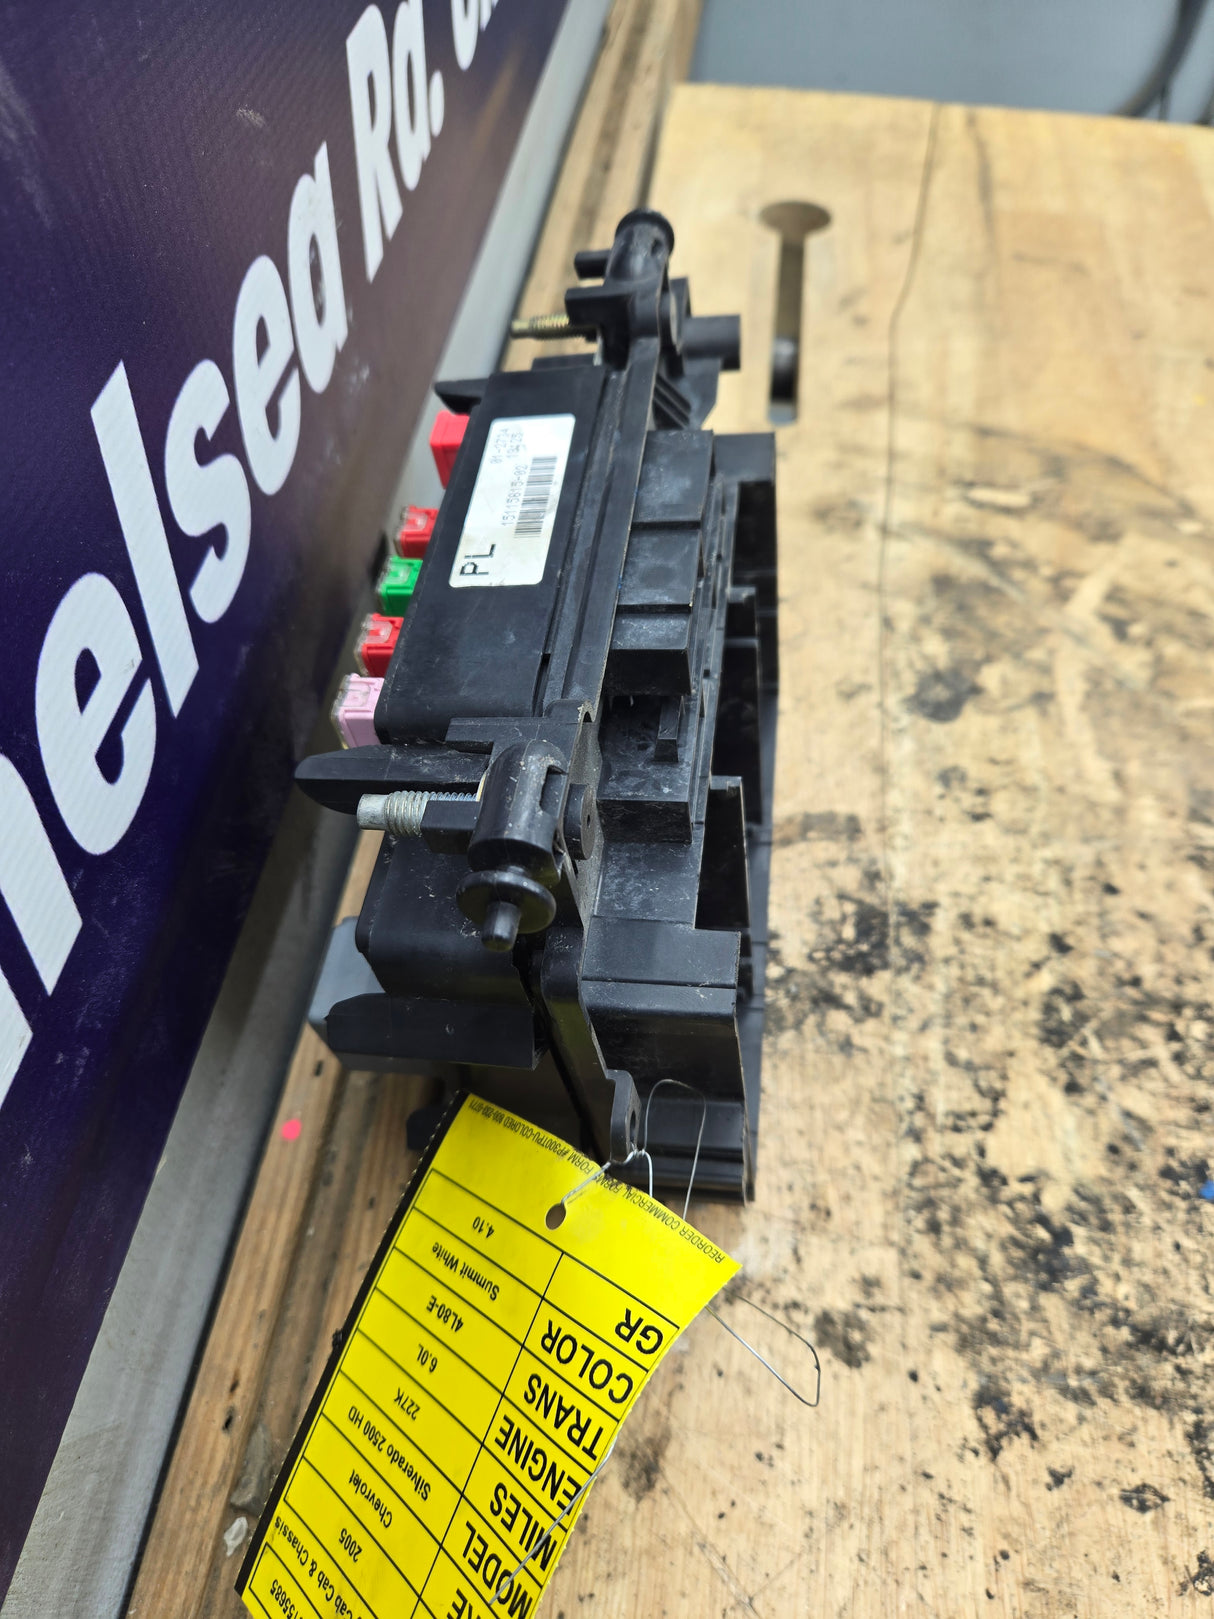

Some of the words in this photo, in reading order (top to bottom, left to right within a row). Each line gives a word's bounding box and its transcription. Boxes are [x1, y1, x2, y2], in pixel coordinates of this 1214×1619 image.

[345, 0, 444, 283] Rd.
[459, 543, 496, 577] PL
[567, 1152, 594, 1175] FORM
[472, 1215, 496, 1240] 4.10
[624, 1186, 681, 1230] COMMERCIAL
[432, 1242, 461, 1275] White
[679, 1227, 725, 1264] REORDER
[456, 1259, 499, 1301] Summit
[426, 1295, 464, 1334] 4L80-E
[614, 1307, 664, 1355] GR
[416, 1343, 439, 1375] 6.0L
[541, 1319, 635, 1405] COLOR
[348, 1405, 366, 1430] HD
[394, 1387, 421, 1420] 227K
[523, 1373, 604, 1461] TRANS
[362, 1418, 387, 1451] 2500
[386, 1443, 432, 1501] Silverado
[494, 1414, 582, 1517] ENGINE
[348, 1469, 393, 1528] Chevrolet
[274, 1515, 309, 1566] Chassis
[339, 1528, 363, 1563] 2005
[490, 1482, 557, 1572] MILES
[308, 1558, 318, 1578] &
[317, 1571, 335, 1602] Cab
[462, 1520, 533, 1619] MODEL
[269, 1579, 304, 1619] 155685
